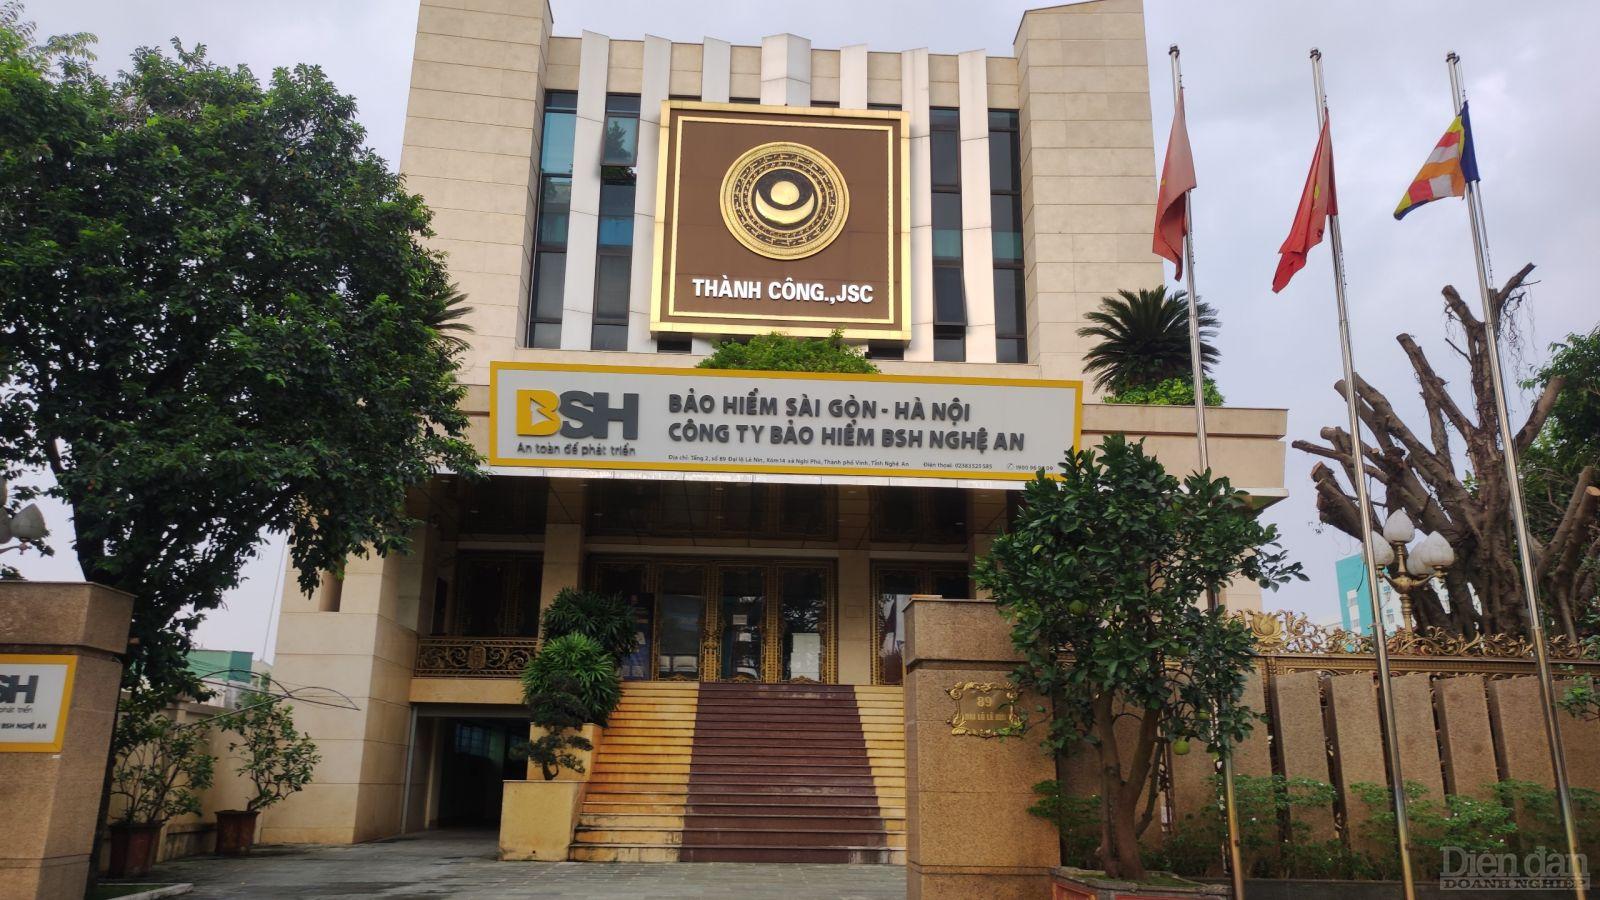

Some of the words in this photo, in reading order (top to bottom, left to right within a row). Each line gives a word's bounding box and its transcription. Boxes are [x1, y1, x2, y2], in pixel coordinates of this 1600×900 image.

[692, 275, 761, 299] THÀNH
[516, 389, 639, 440] BSH
[668, 387, 715, 414] BẢO
[722, 387, 778, 416] HIỂM
[785, 393, 821, 418] SÀI
[828, 394, 877, 419] GÒN
[894, 396, 925, 420] HÀ
[931, 397, 970, 426] NỘI
[668, 418, 730, 444] CÔNG
[736, 424, 765, 444] TY
[769, 419, 814, 446] BẢO
[821, 419, 875, 447] HIỂM
[881, 428, 923, 449] BSH
[929, 426, 988, 454] NGHỆ
[993, 432, 1025, 451] AN
[516, 442, 532, 454] An
[535, 442, 560, 455] toàn
[564, 441, 580, 455] để
[581, 442, 606, 456] phát
[610, 442, 636, 456] triển
[976, 696, 992, 707] 89
[36, 722, 47, 730] AN
